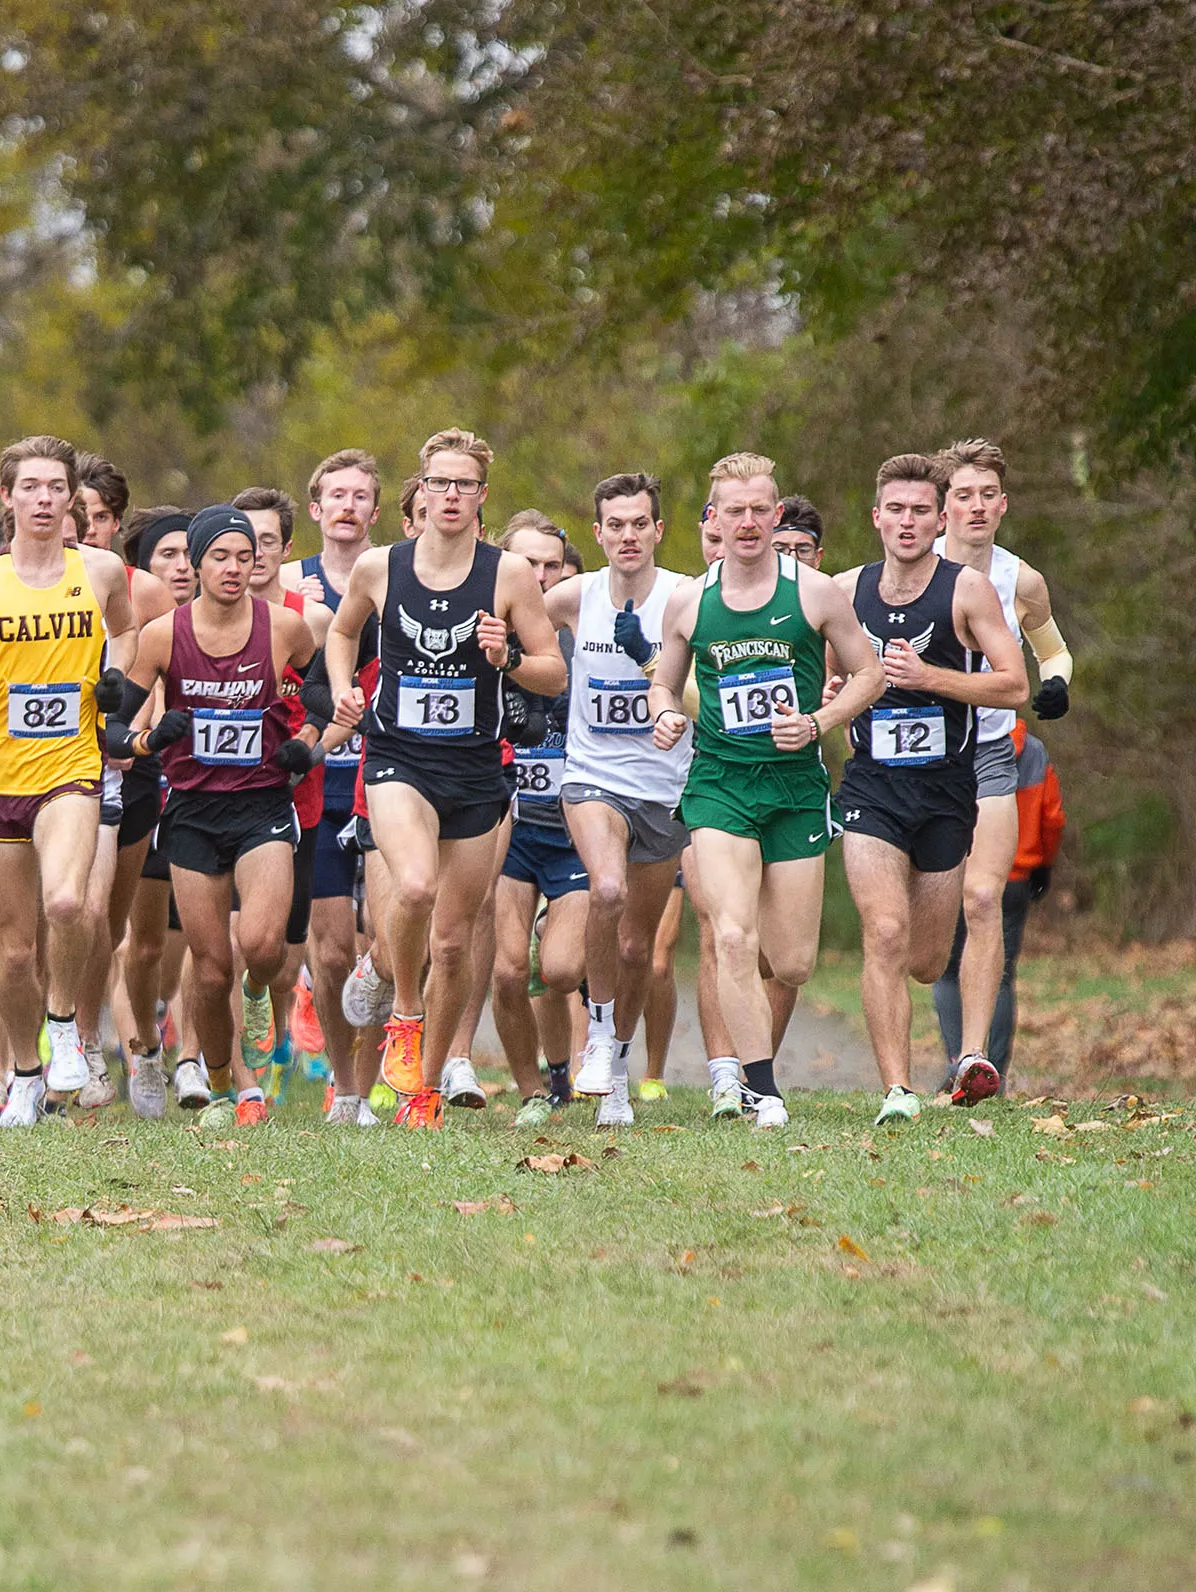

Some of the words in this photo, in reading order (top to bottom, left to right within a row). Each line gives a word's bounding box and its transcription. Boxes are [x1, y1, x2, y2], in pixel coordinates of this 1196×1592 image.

[582, 641, 613, 653] JOHN
[709, 639, 792, 671] FRANCISCAN
[406, 660, 467, 671] ADRIAN
[414, 667, 460, 677] COLLEGE
[181, 679, 264, 696] EARLHAM
[23, 697, 67, 729] 82
[416, 693, 460, 726] 13
[591, 694, 651, 724] 180
[727, 684, 794, 723] 139
[197, 724, 261, 755] 127
[888, 722, 932, 756] 12
